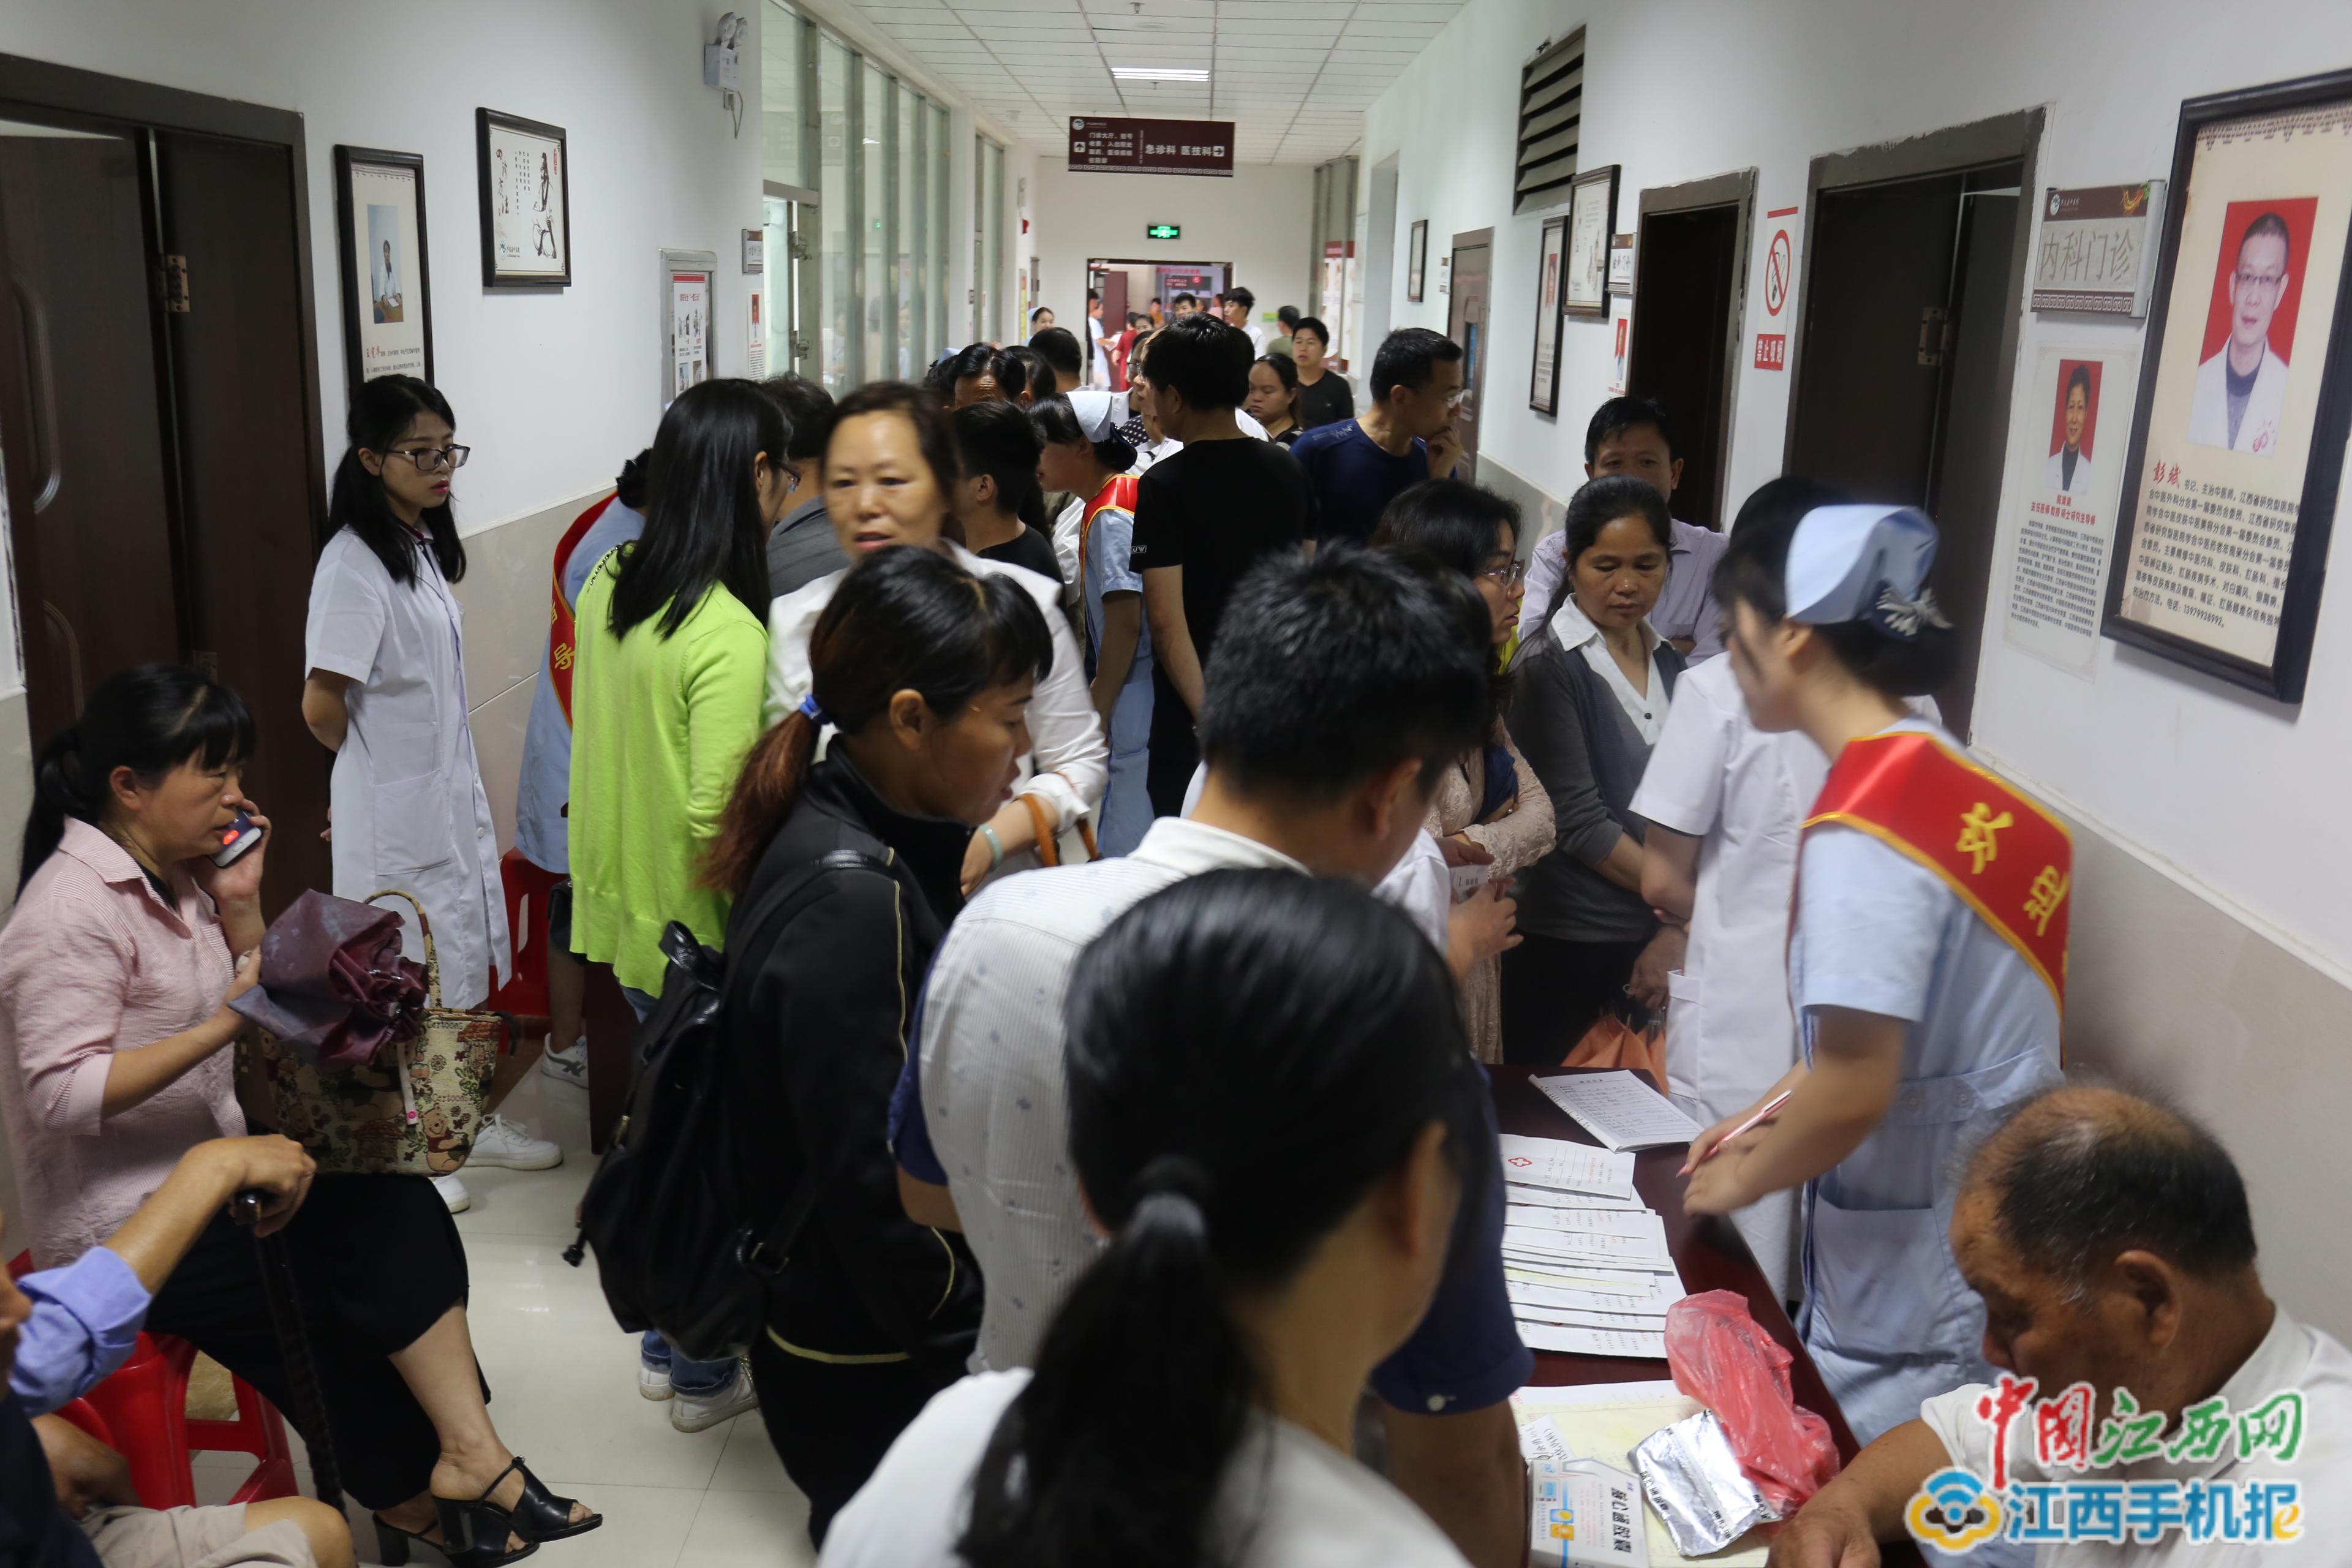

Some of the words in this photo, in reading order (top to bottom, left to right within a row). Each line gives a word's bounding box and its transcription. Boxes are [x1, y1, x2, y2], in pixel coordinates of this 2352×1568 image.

[1145, 145, 1177, 155] 急诊科
[1181, 146, 1212, 156] 医技科
[2039, 228, 2134, 282] 内科门诊
[1756, 339, 1784, 363] 禁止吸烟
[427, 1020, 464, 1030] Cartoons
[431, 1093, 470, 1103] Cartoons
